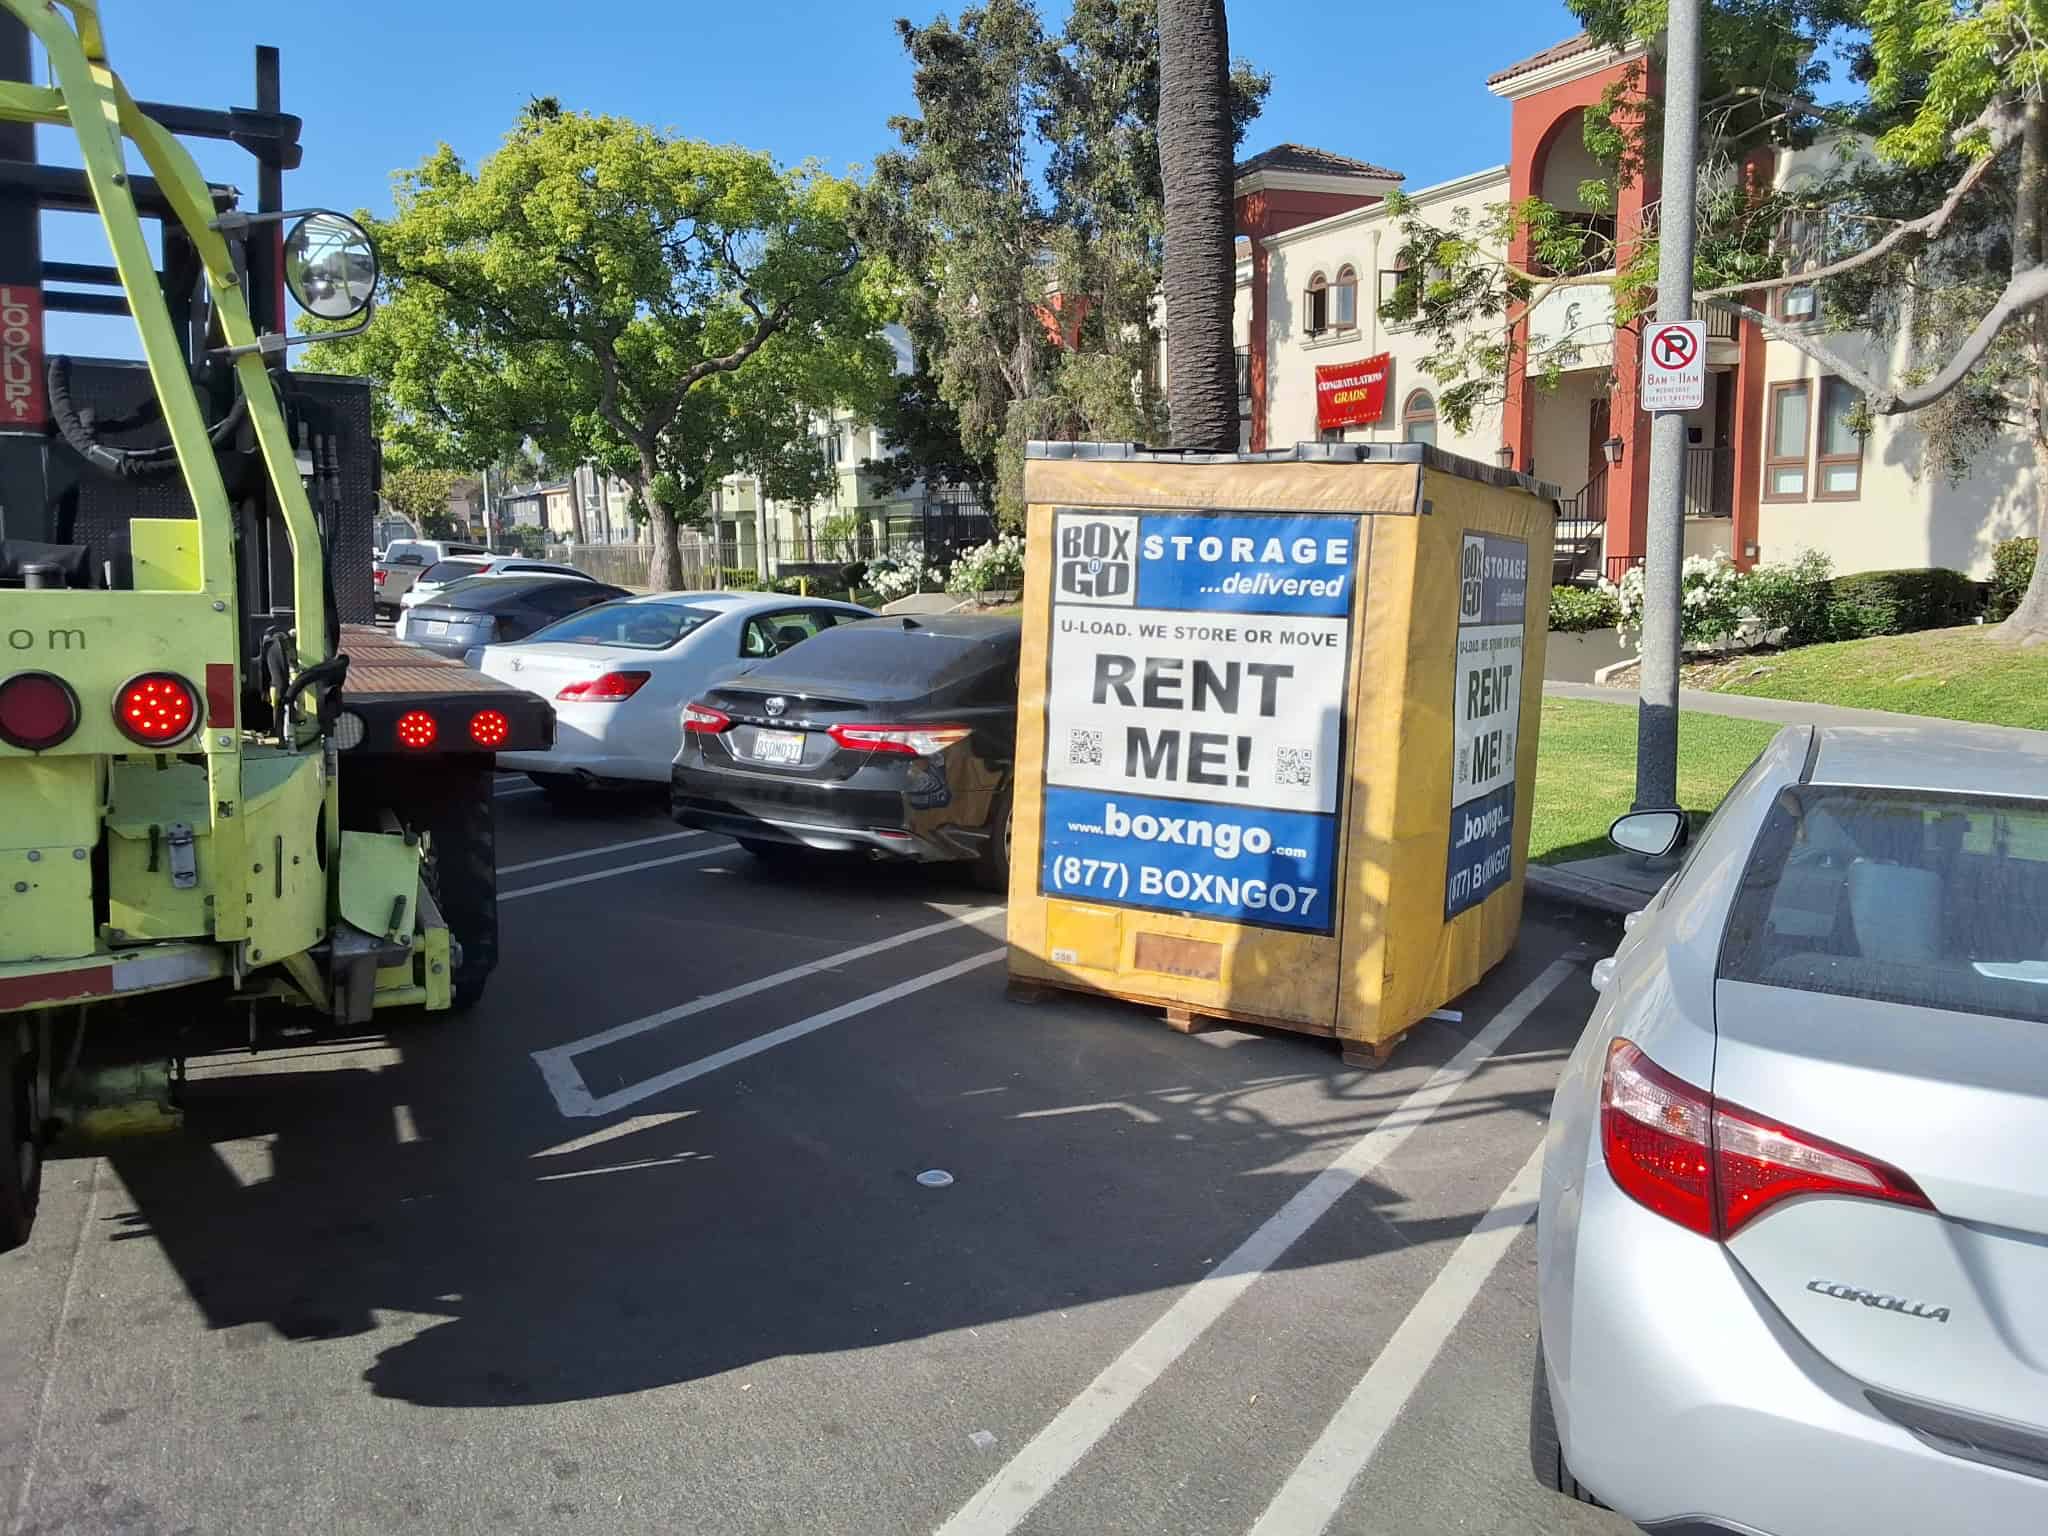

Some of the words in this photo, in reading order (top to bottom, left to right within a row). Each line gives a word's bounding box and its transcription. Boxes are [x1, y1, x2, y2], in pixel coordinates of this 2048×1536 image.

[1062, 522, 1130, 561] BOX
[1143, 535, 1348, 565] STORAGE
[1061, 560, 1130, 598] GO
[1200, 572, 1343, 597] ...delivered
[1485, 556, 1526, 580] STORAGE
[1061, 619, 1132, 637] U-LOAD.
[1139, 624, 1167, 639] WE
[1175, 626, 1237, 642] STORE
[1244, 629, 1273, 645] OR
[1280, 631, 1338, 647] MOVE
[1092, 653, 1294, 717] RENT
[1467, 665, 1512, 720] RENT
[1124, 726, 1252, 788] ME!
[1472, 729, 1502, 785] ME!
[1053, 855, 1129, 898] (877)
[1140, 866, 1317, 915] BOXNGO7
[1807, 1280, 1950, 1323] COROLLA
